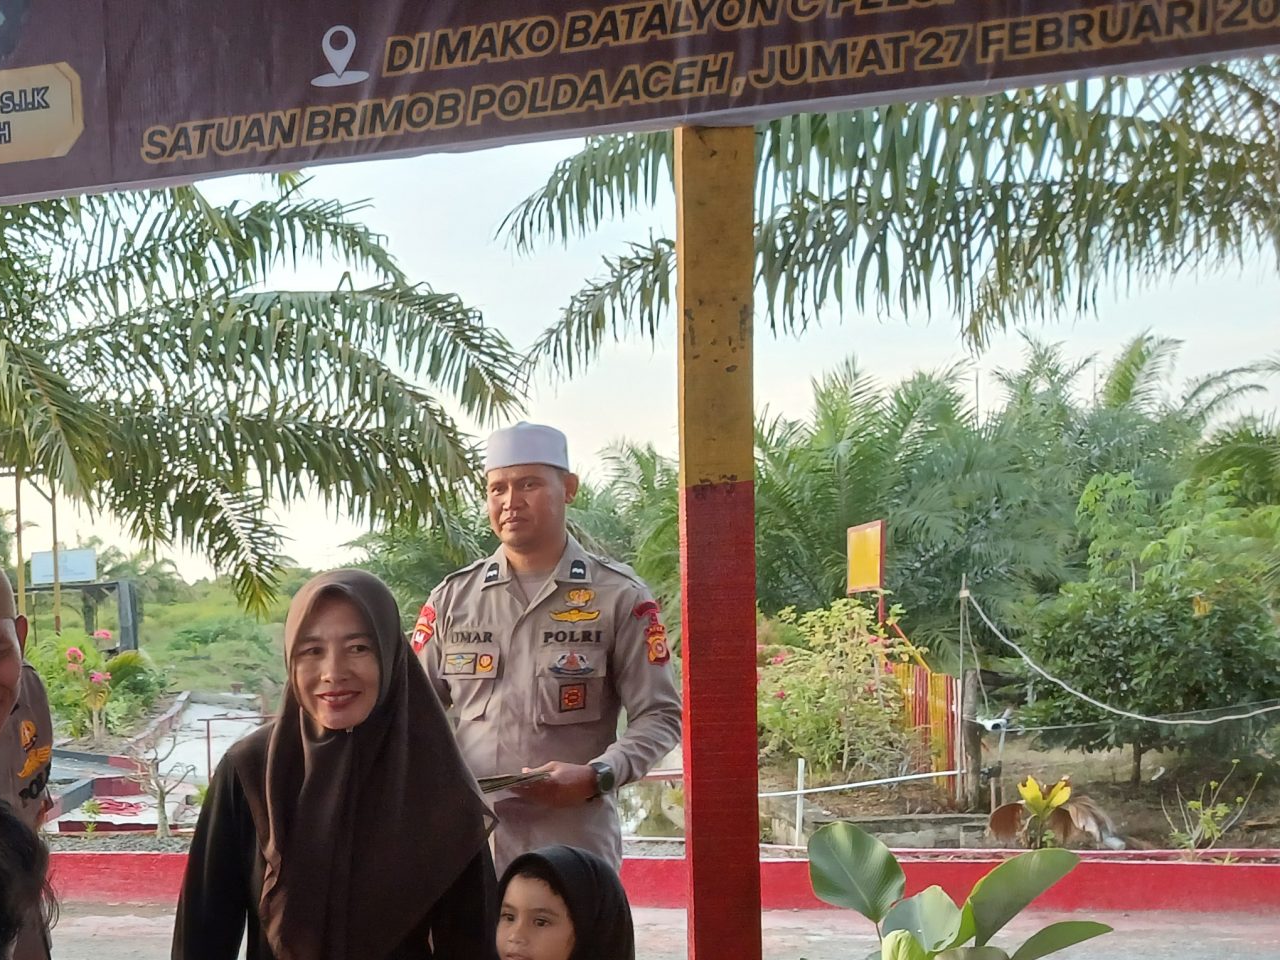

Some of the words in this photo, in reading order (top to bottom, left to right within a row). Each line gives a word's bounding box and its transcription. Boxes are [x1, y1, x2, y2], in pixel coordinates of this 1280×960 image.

[386, 37, 424, 75] DI
[434, 21, 556, 66] MAKO
[566, 0, 777, 50] BATALYON
[144, 112, 296, 161] SATUAN
[306, 94, 462, 141] BRIMOB
[470, 79, 604, 122] POLDA
[617, 56, 745, 102] ACEH,
[752, 34, 910, 85] JUM'AT
[919, 28, 973, 66] 27
[979, 0, 1208, 60] FEBRUARI
[0, 85, 51, 114] S.I.K
[450, 630, 494, 645] UMAR
[542, 630, 603, 644] POLRI
